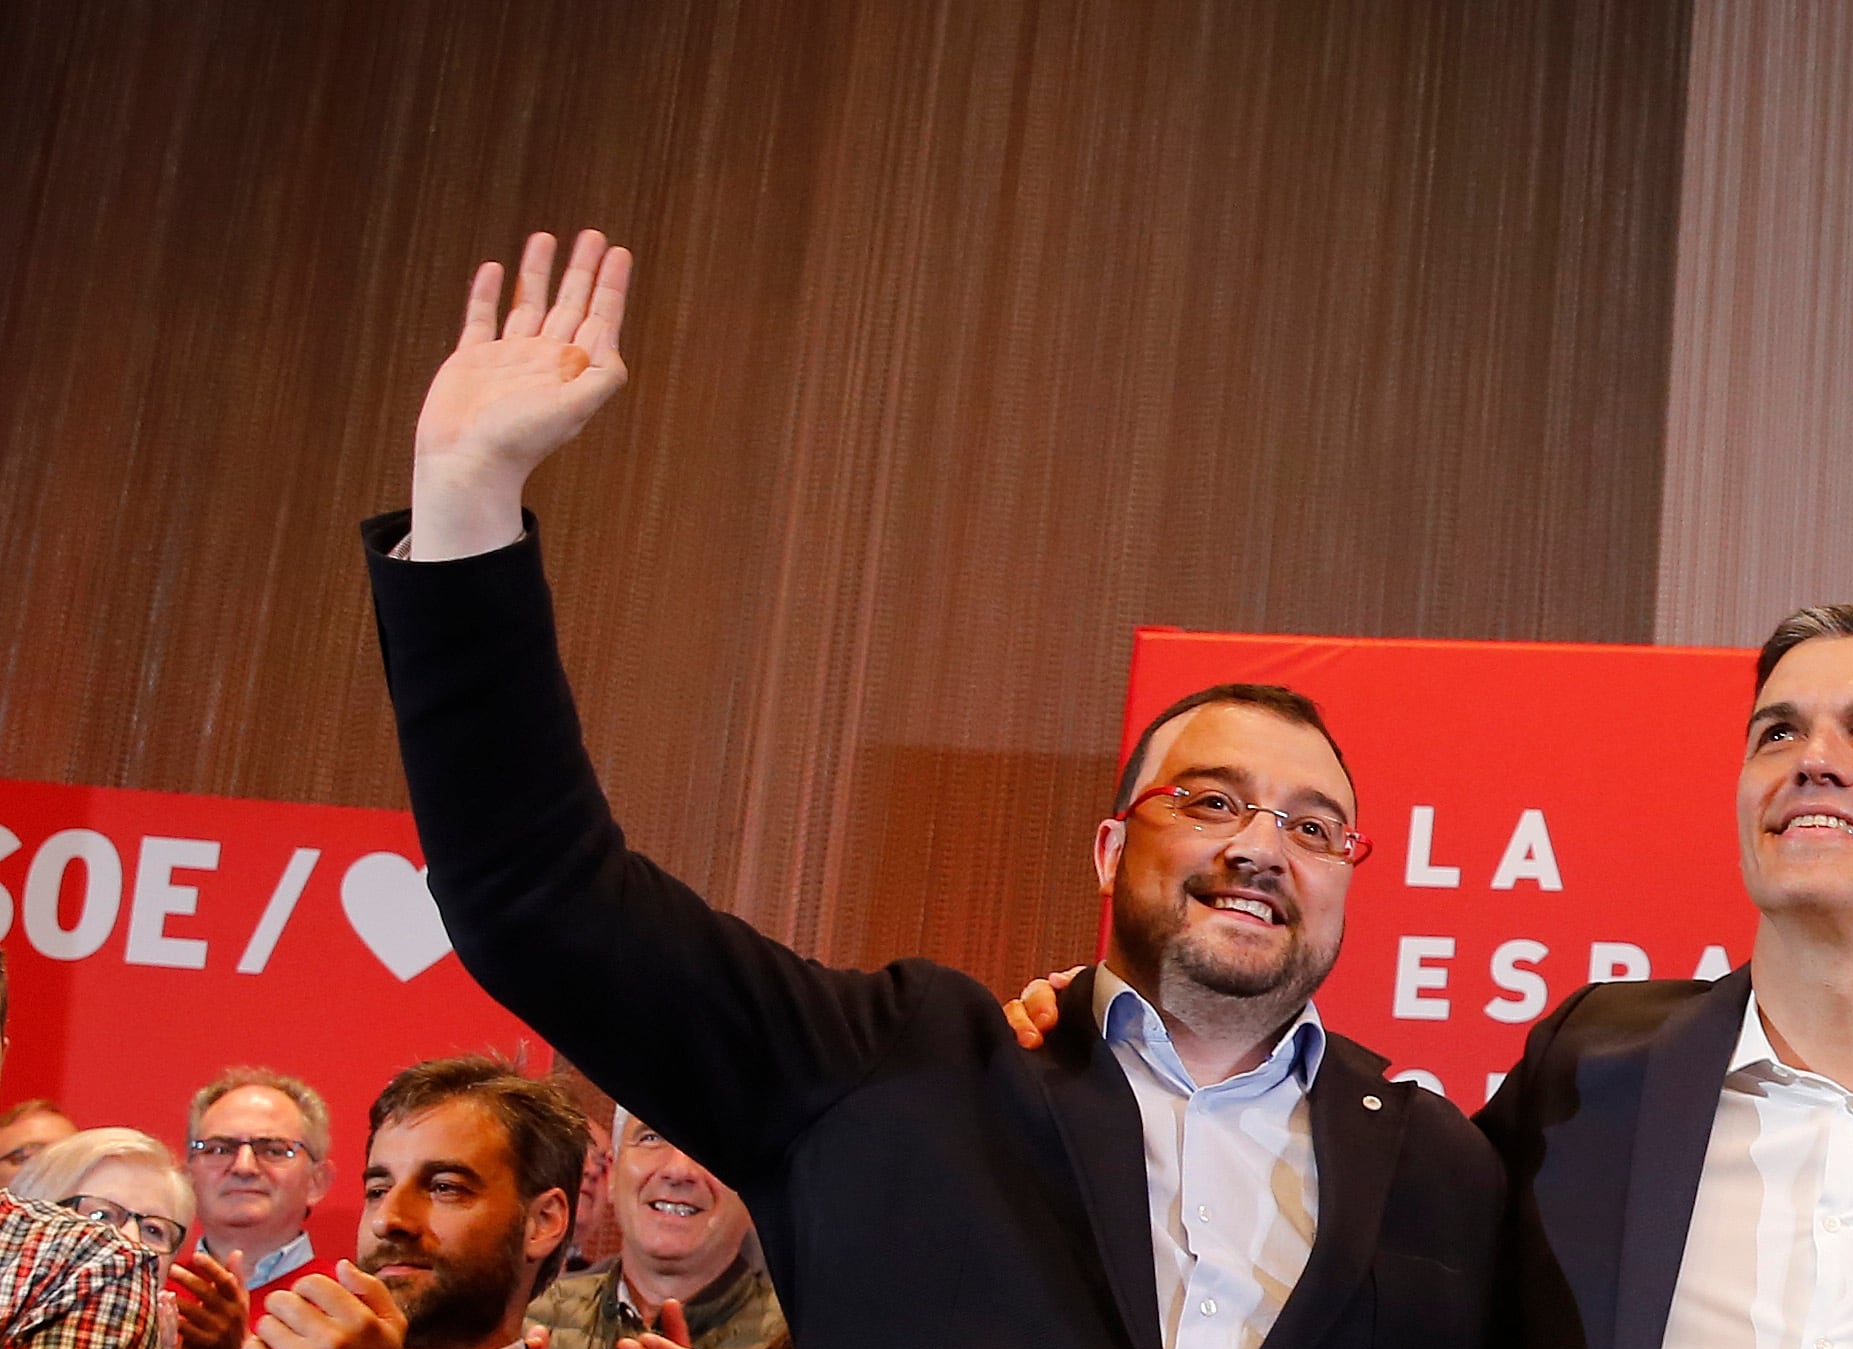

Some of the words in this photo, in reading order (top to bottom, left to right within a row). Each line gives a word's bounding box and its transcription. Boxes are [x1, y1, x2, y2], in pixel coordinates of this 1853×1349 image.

[1405, 805, 1563, 891] LA
[0, 825, 221, 969] OE
[1393, 936, 1732, 1022] ESP
